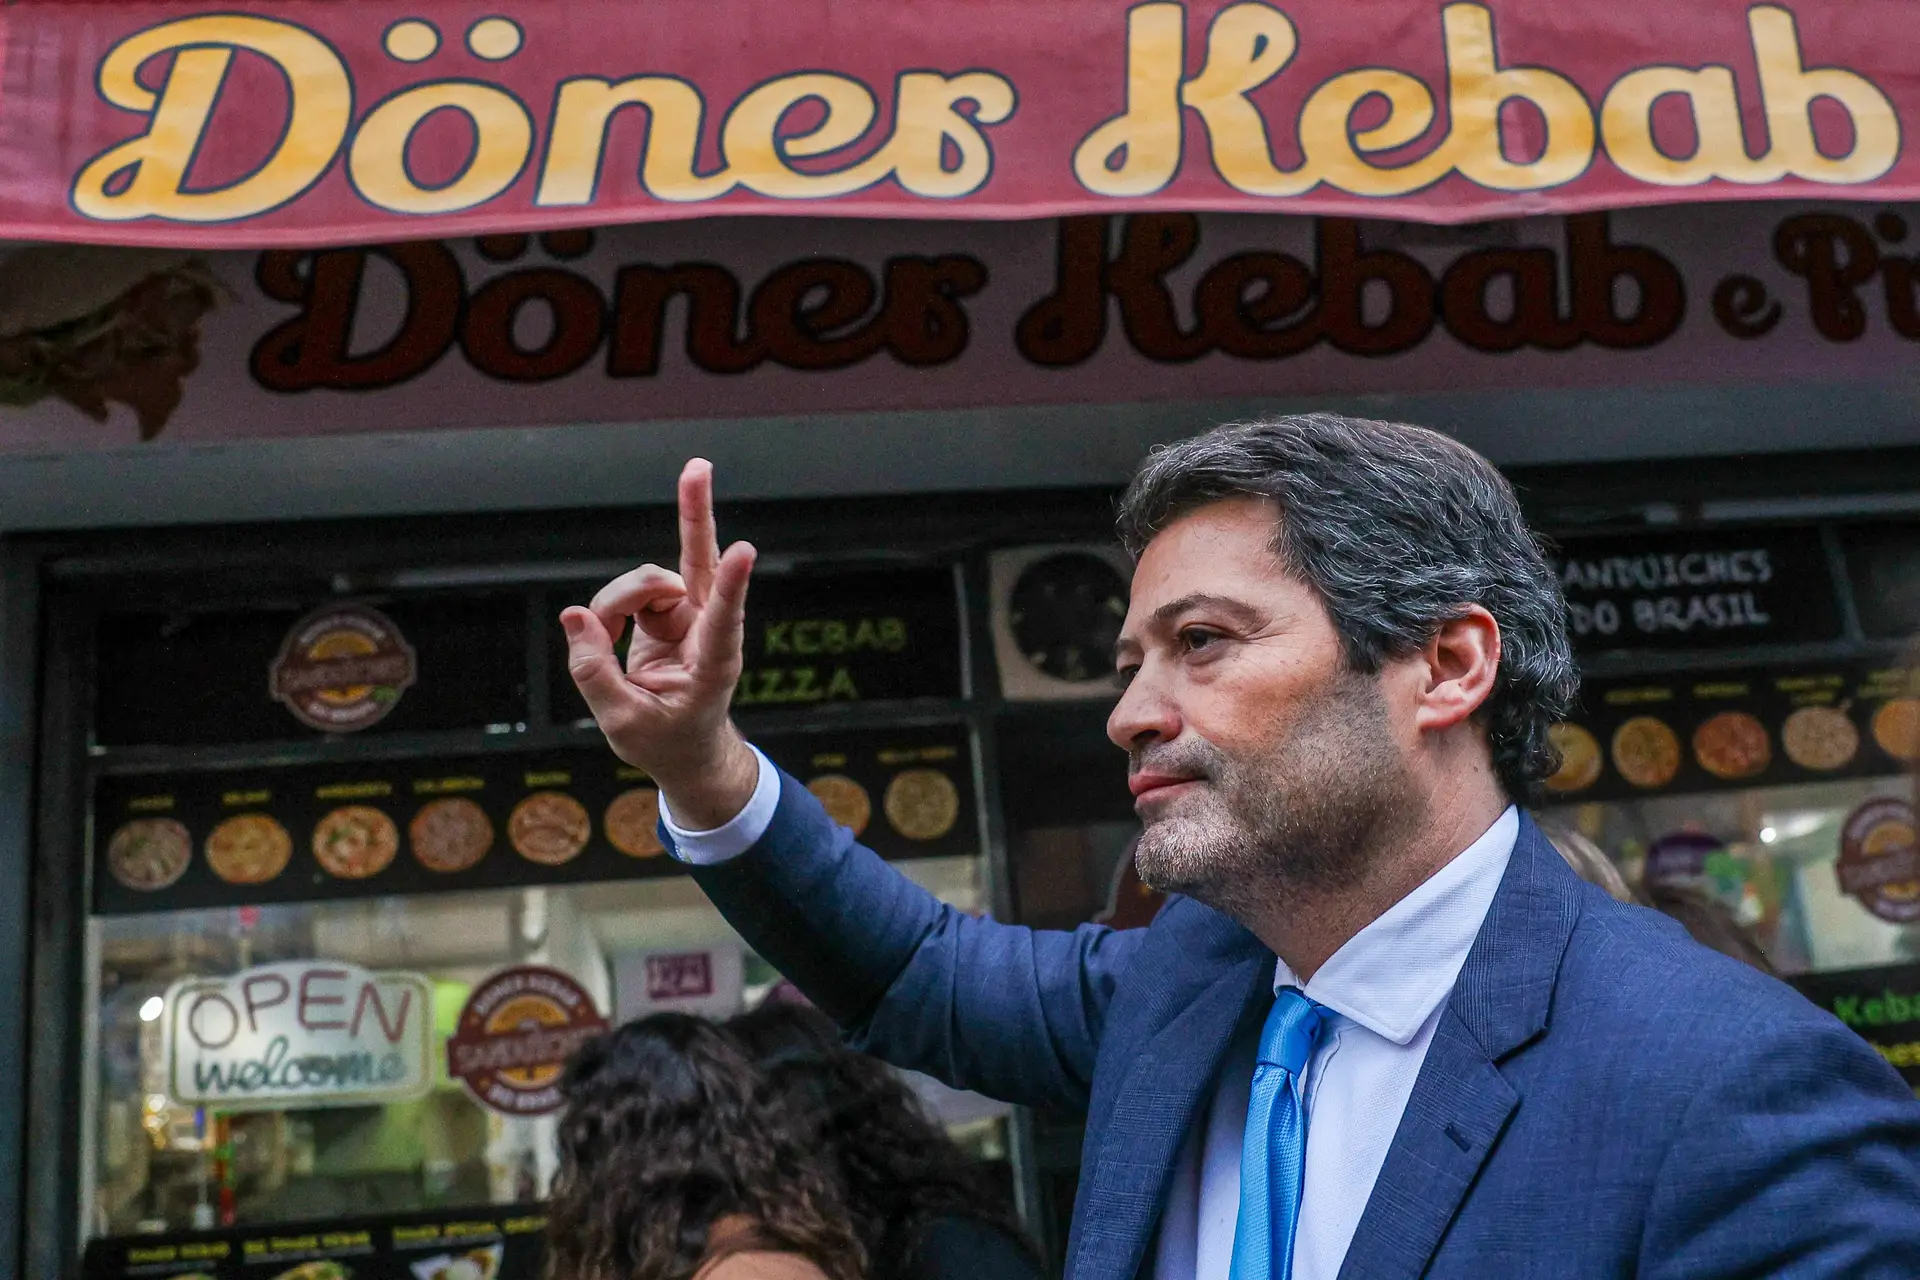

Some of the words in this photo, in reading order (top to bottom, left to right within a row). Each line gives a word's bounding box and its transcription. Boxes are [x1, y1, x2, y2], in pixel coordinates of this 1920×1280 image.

[71, 11, 1018, 223] Döner
[1072, 0, 1901, 198] Kebab
[250, 230, 988, 391] Döner
[1015, 211, 1686, 368] Kebab
[1713, 274, 1783, 338] e
[1551, 550, 1772, 589] ANDUICHES
[1633, 591, 1771, 632] BRASIL
[738, 666, 859, 702] IZZA
[187, 968, 412, 1050] OPEN
[195, 1034, 405, 1093] welcome
